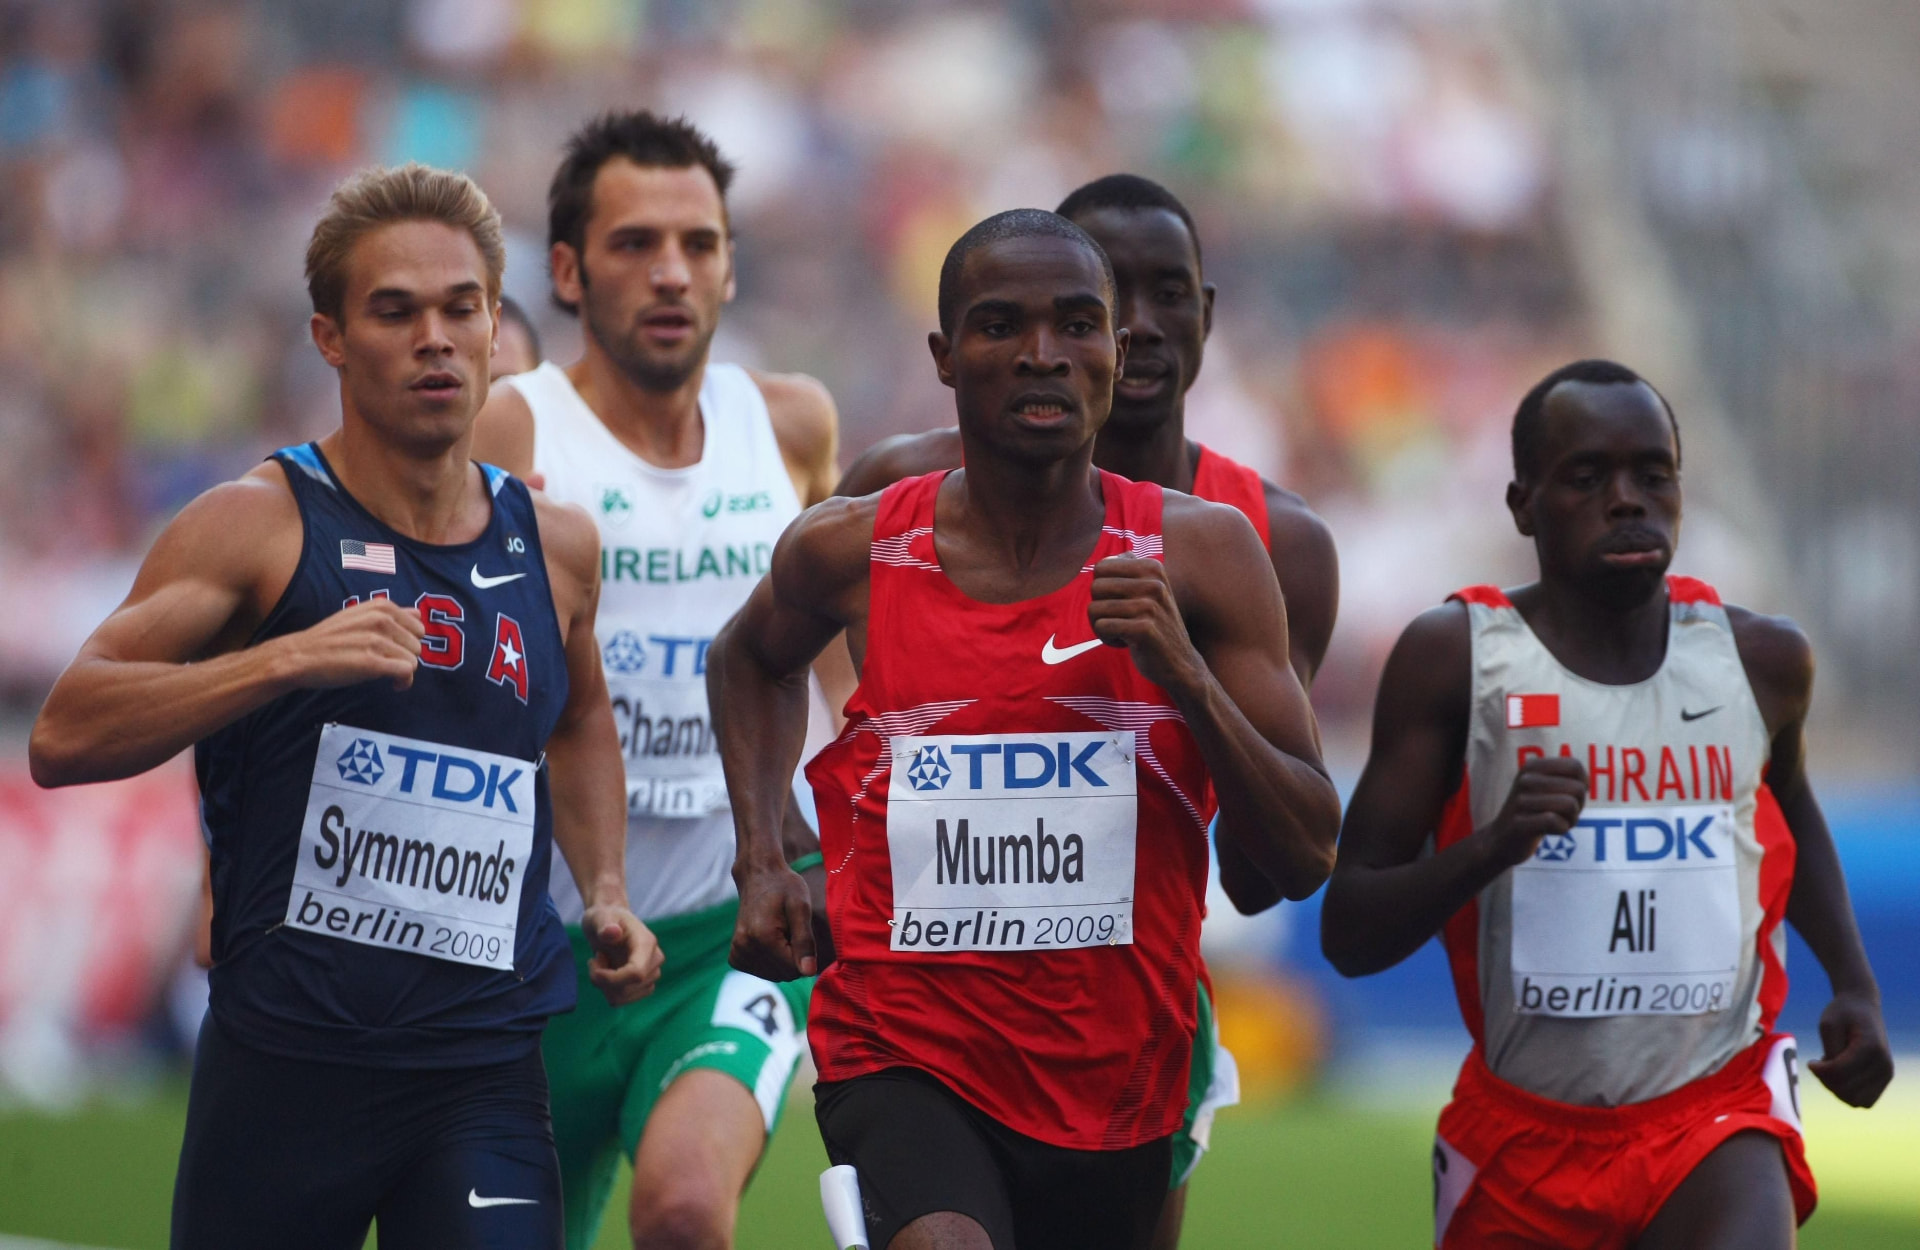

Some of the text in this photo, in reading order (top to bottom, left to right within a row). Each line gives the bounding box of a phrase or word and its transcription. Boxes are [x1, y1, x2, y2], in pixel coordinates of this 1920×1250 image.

[507, 537, 525, 554] JO
[601, 542, 771, 583] IRELAND
[343, 588, 529, 706] SA
[387, 747, 523, 814] TDK
[951, 741, 1109, 790] TDK
[1517, 743, 1734, 803] HRAIN
[313, 804, 514, 905] Symmonds
[936, 817, 1084, 885] Mumba
[1575, 815, 1718, 862] TDK
[296, 892, 500, 963] berlin 2009
[900, 911, 1025, 946] berlin
[1034, 914, 1115, 945] 2009
[1609, 889, 1656, 953] Ali
[1521, 976, 1642, 1012] berlin
